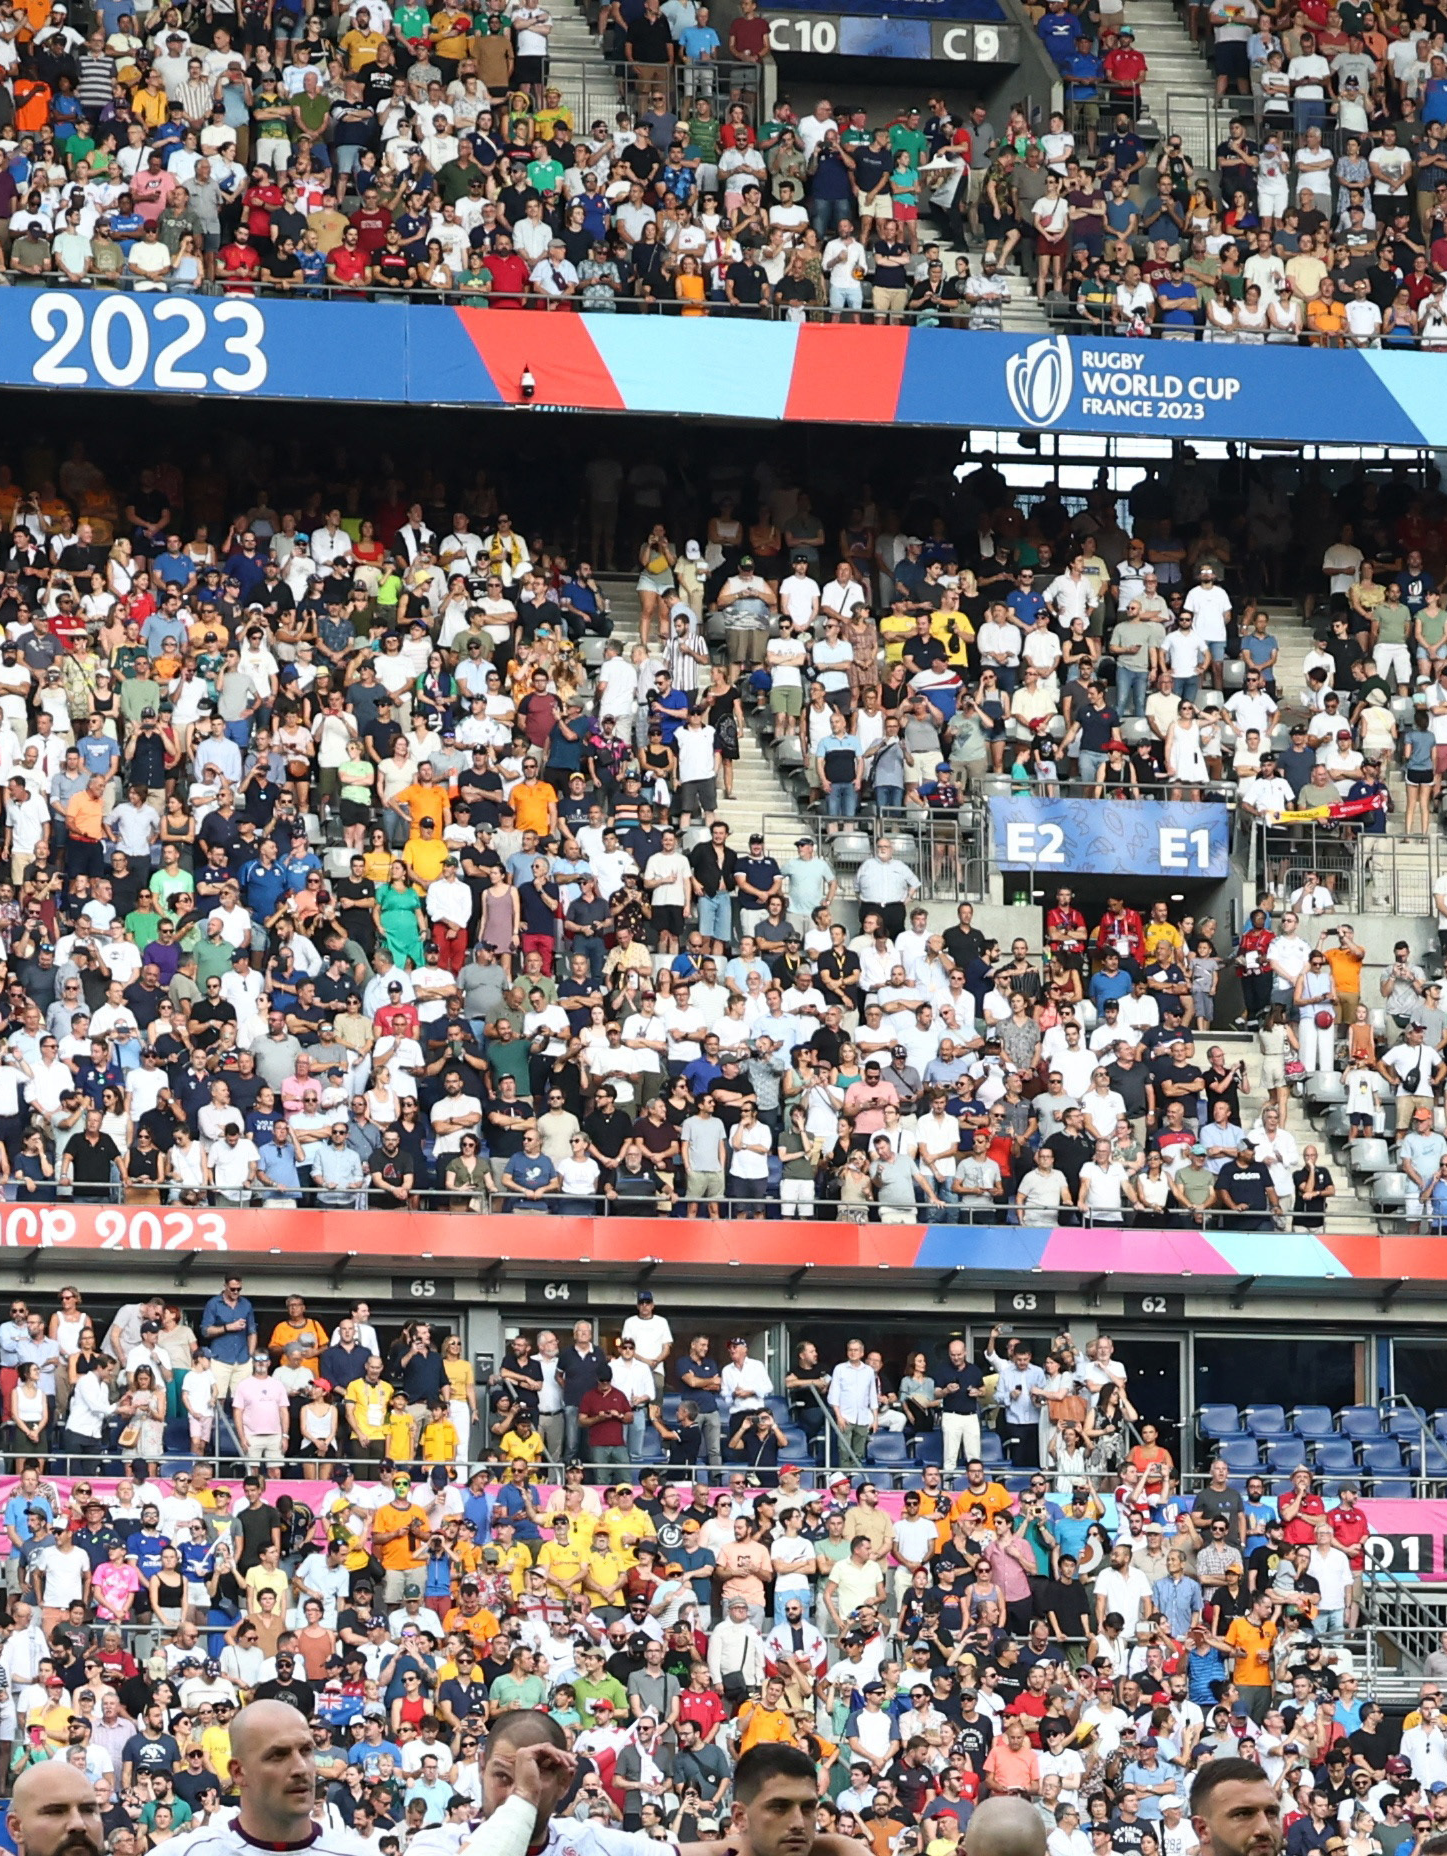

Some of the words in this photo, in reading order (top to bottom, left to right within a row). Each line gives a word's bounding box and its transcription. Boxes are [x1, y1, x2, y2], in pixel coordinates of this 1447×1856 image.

[30, 294, 269, 393] 2023
[1081, 350, 1145, 371] RUGBY
[1081, 371, 1184, 399] WORLD
[1187, 376, 1241, 402] CUP
[1081, 396, 1154, 417] FRANCE
[1156, 400, 1206, 421] 2023
[1005, 823, 1065, 863] E2
[1159, 828, 1210, 869] E1
[93, 1209, 227, 1250] 2023
[410, 1280, 436, 1297] 65
[543, 1283, 570, 1300] 64
[1012, 1293, 1037, 1310] 63
[1141, 1297, 1167, 1313] 62
